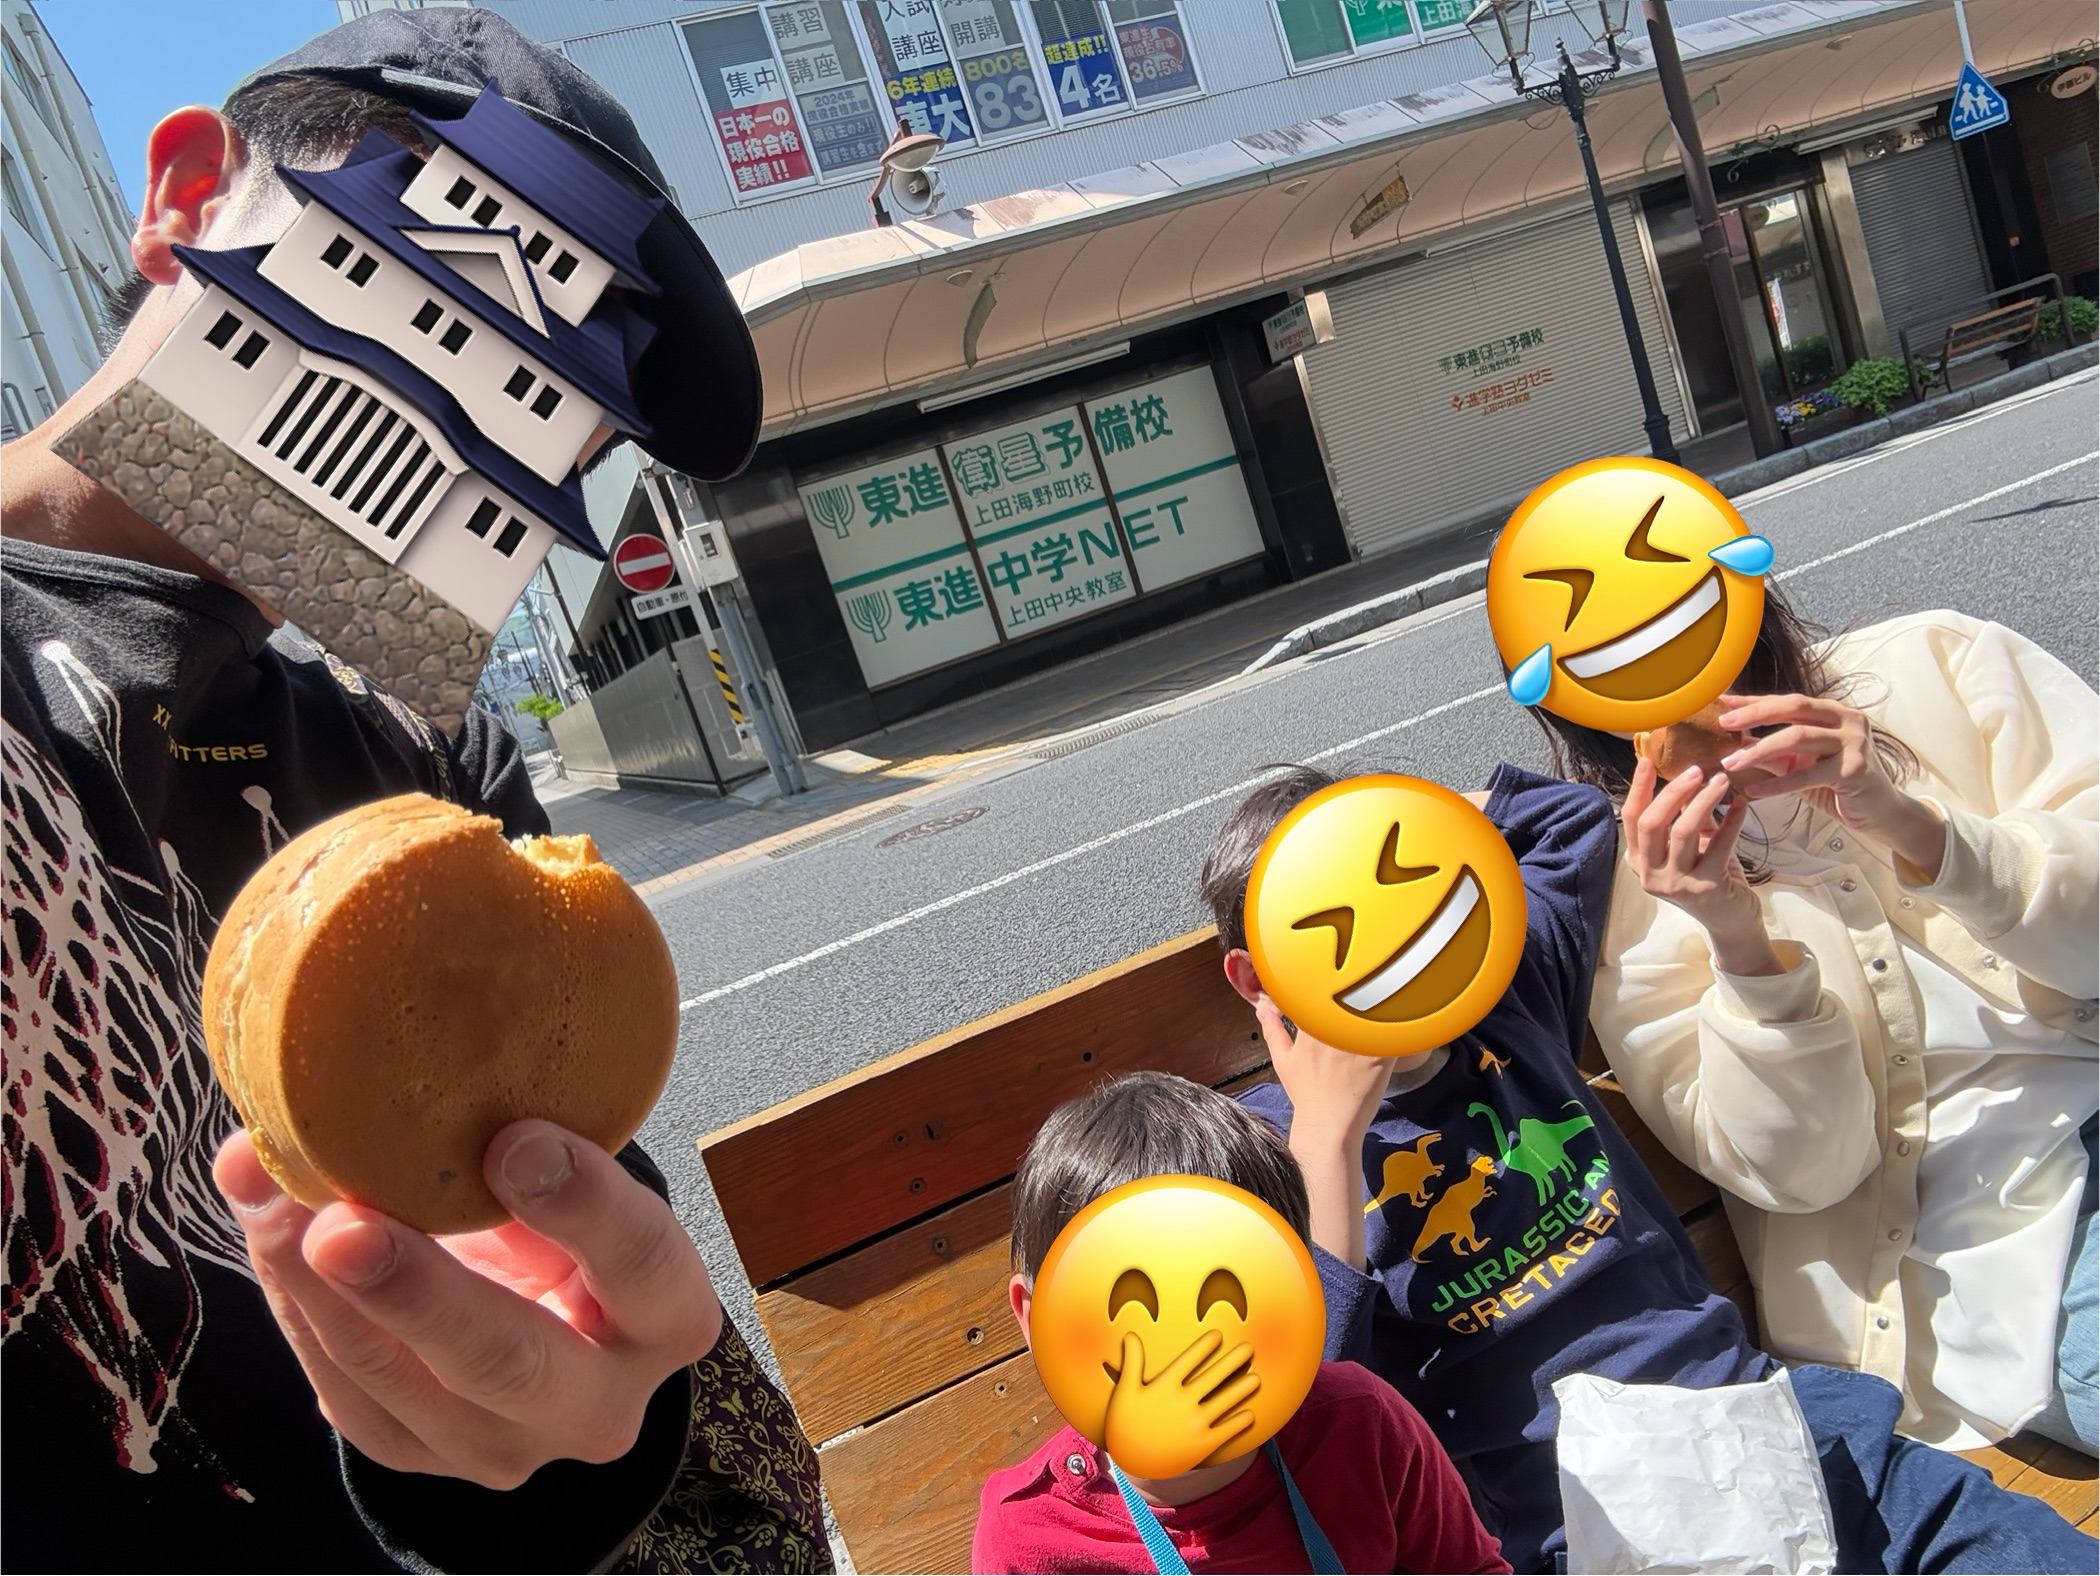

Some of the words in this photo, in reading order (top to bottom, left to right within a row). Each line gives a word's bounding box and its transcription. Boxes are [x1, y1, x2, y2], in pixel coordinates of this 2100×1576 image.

[771, 8, 824, 39] 講習
[951, 15, 1000, 47] 開講
[892, 30, 943, 61] 講座
[1044, 35, 1108, 65] 超達成!!
[786, 53, 841, 86] 講座
[964, 51, 1029, 81] 800名
[1129, 59, 1184, 83] 36.5%
[726, 67, 778, 99] 集中
[814, 90, 855, 107] 2024年
[887, 68, 957, 100] 6年連続
[1059, 64, 1121, 109] 4名
[895, 94, 970, 142] 東大
[975, 75, 1043, 129] 83
[718, 107, 790, 139] 日本一の
[727, 131, 800, 163] 現役合格
[735, 160, 790, 189] 実績!!
[973, 471, 1096, 528] 上田海野町校
[1007, 570, 1128, 628] 上田中央教室
[168, 735, 269, 763] ATTERS
[1432, 1189, 1589, 1312] JURASSIC
